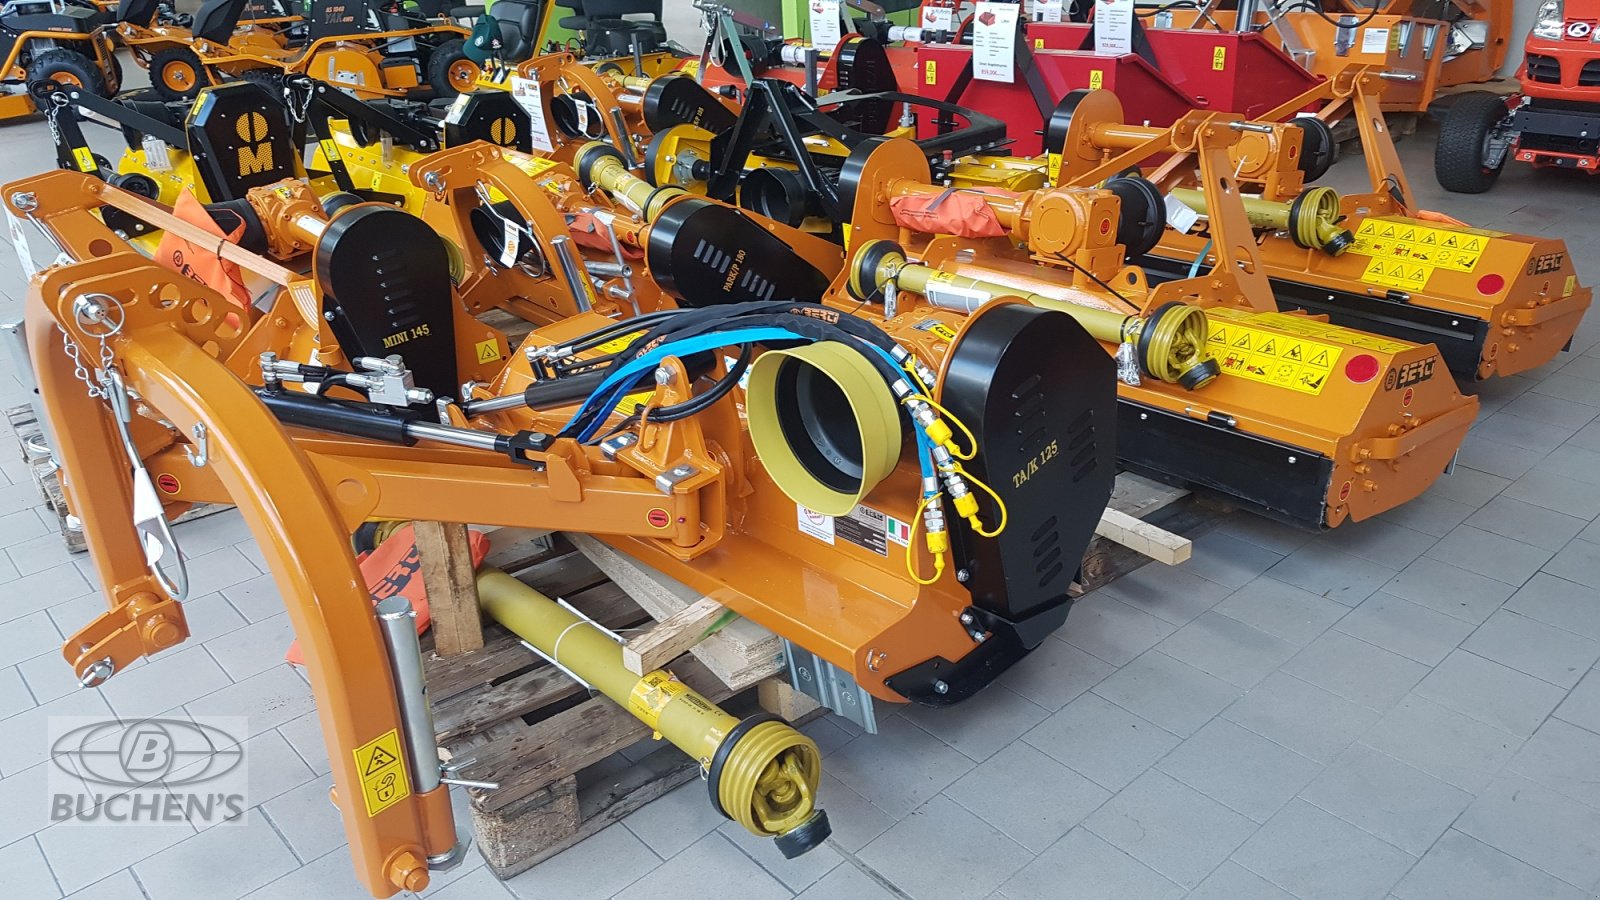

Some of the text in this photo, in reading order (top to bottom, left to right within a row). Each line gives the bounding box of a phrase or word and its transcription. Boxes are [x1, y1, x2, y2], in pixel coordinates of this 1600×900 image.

[722, 249, 746, 292] PARK/P 180
[382, 323, 430, 349] MINI 145
[1012, 439, 1058, 489] TA/K 125
